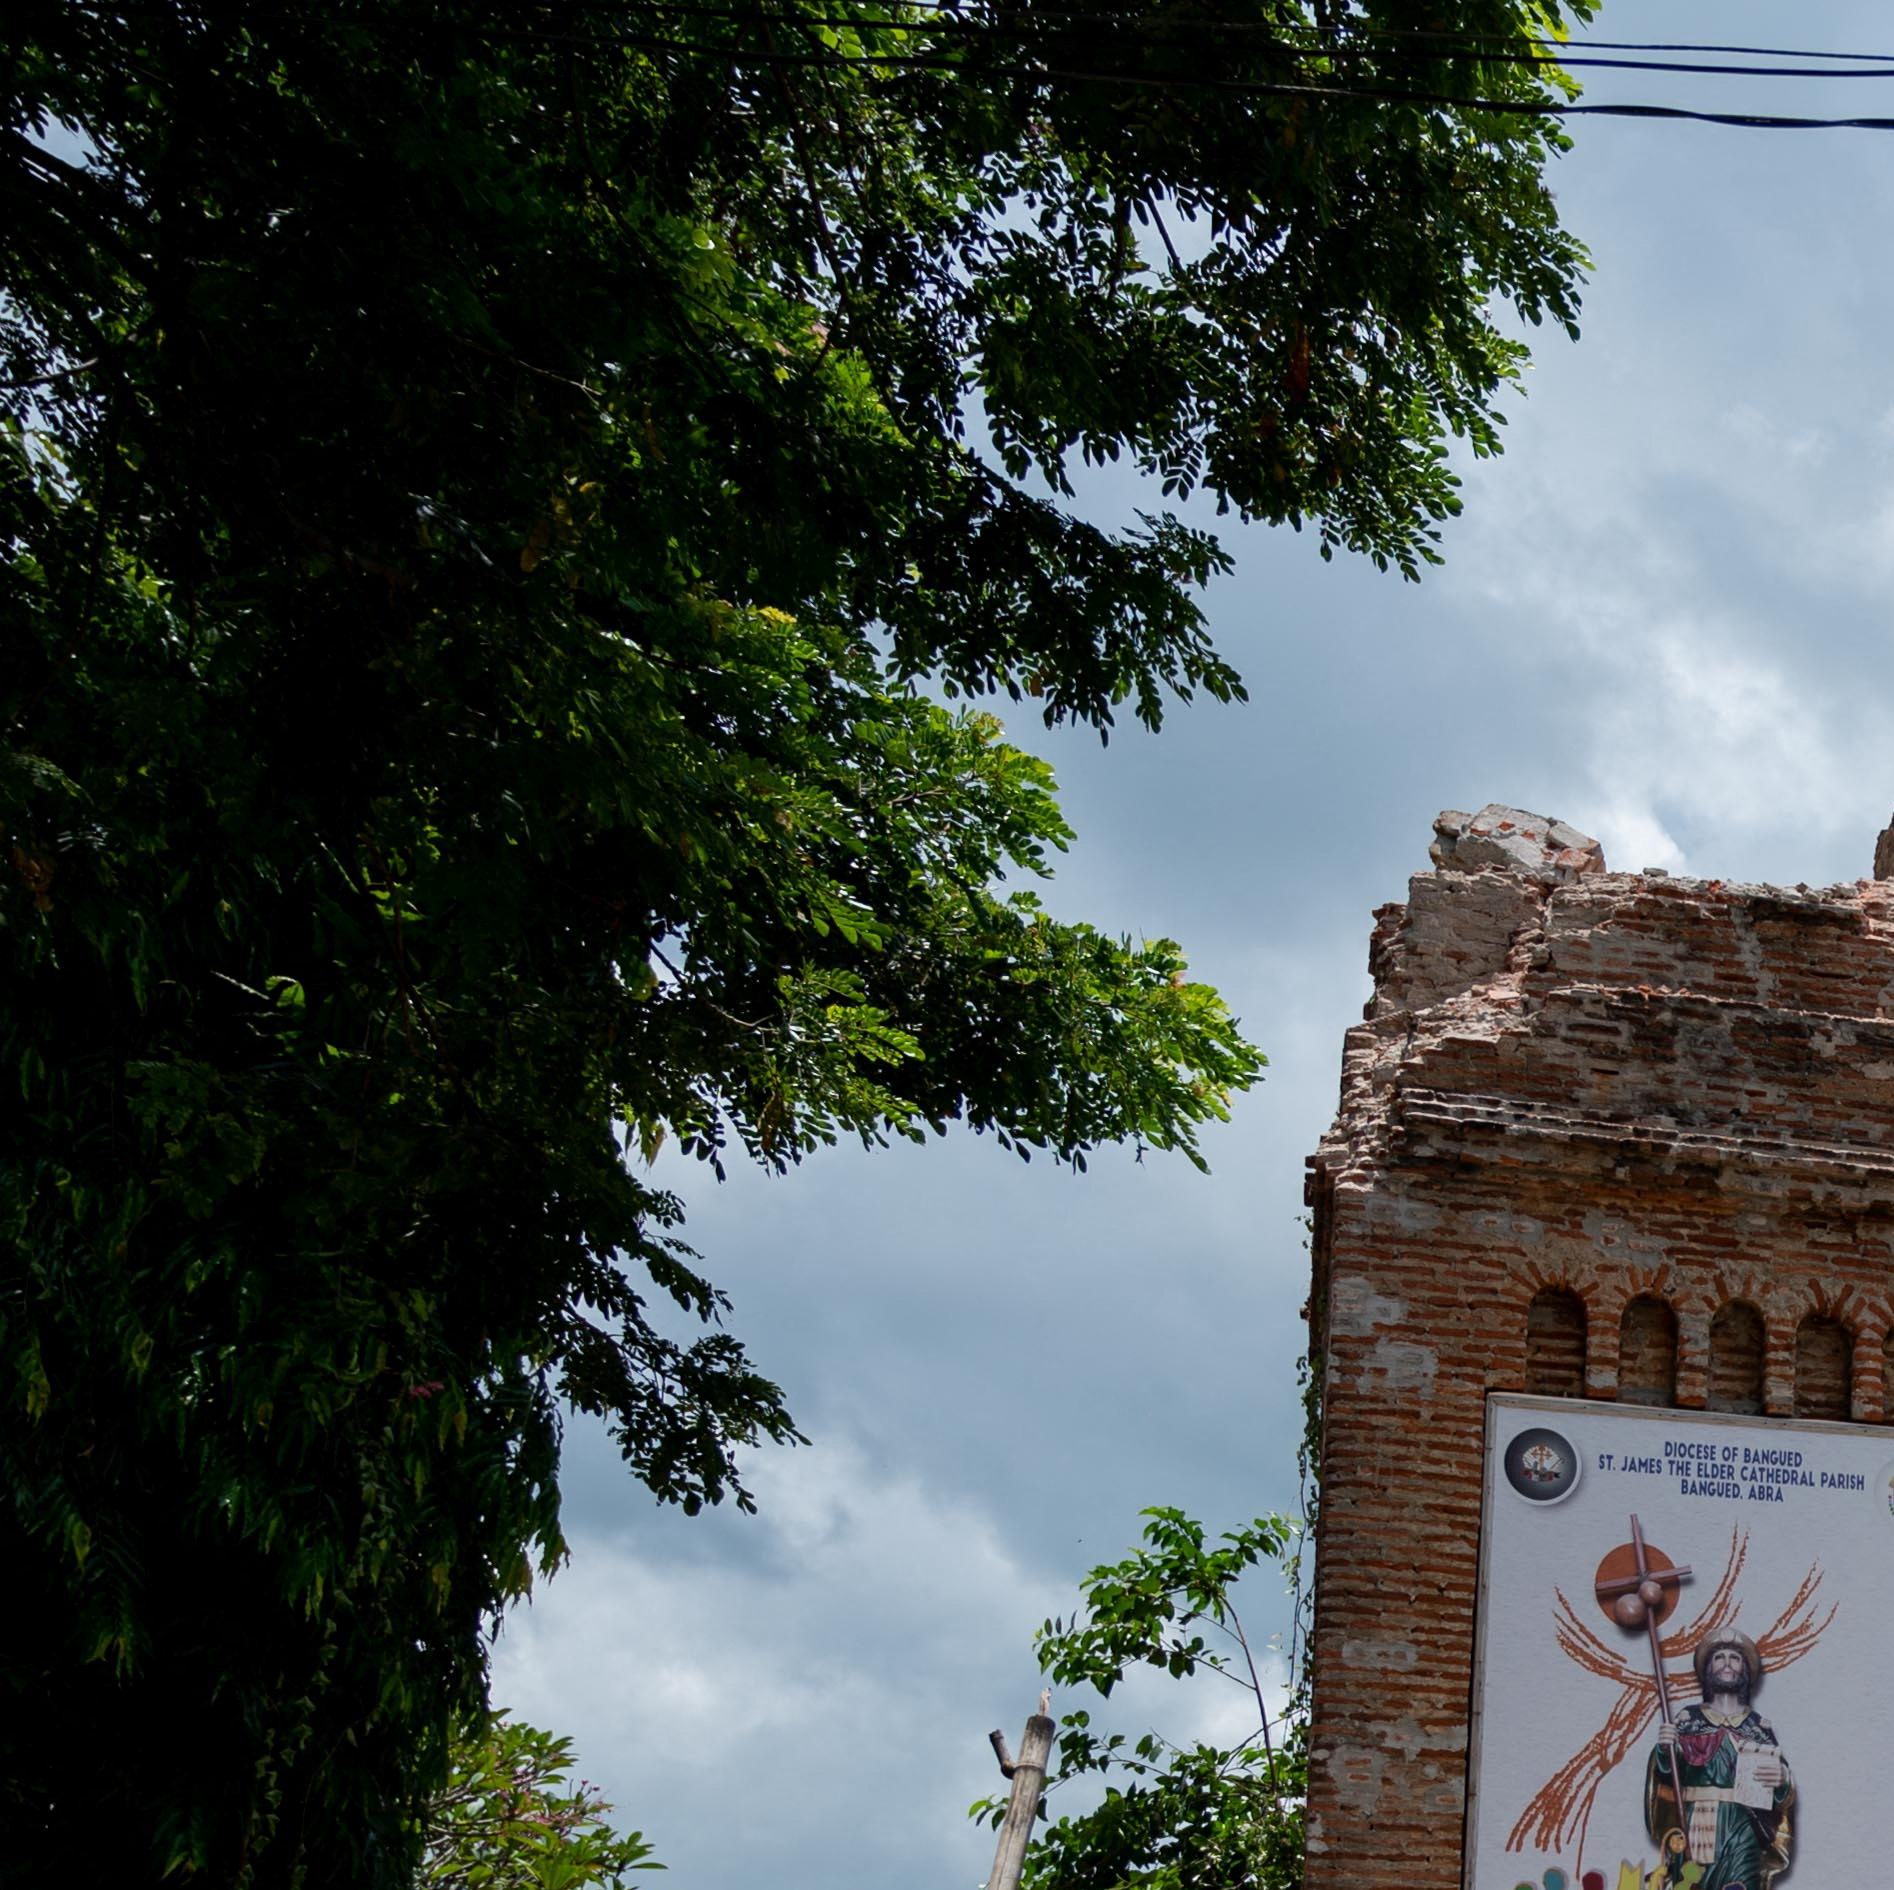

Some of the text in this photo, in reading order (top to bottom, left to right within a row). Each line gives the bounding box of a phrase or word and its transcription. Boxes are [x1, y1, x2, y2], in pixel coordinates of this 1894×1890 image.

[1664, 1441, 1803, 1468] DIOCESE OF BANGUED
[1598, 1453, 1865, 1491] ST. JAMES THE ELDER CATHEDRAL PARISH
[1748, 1484, 1784, 1502] ABRA
